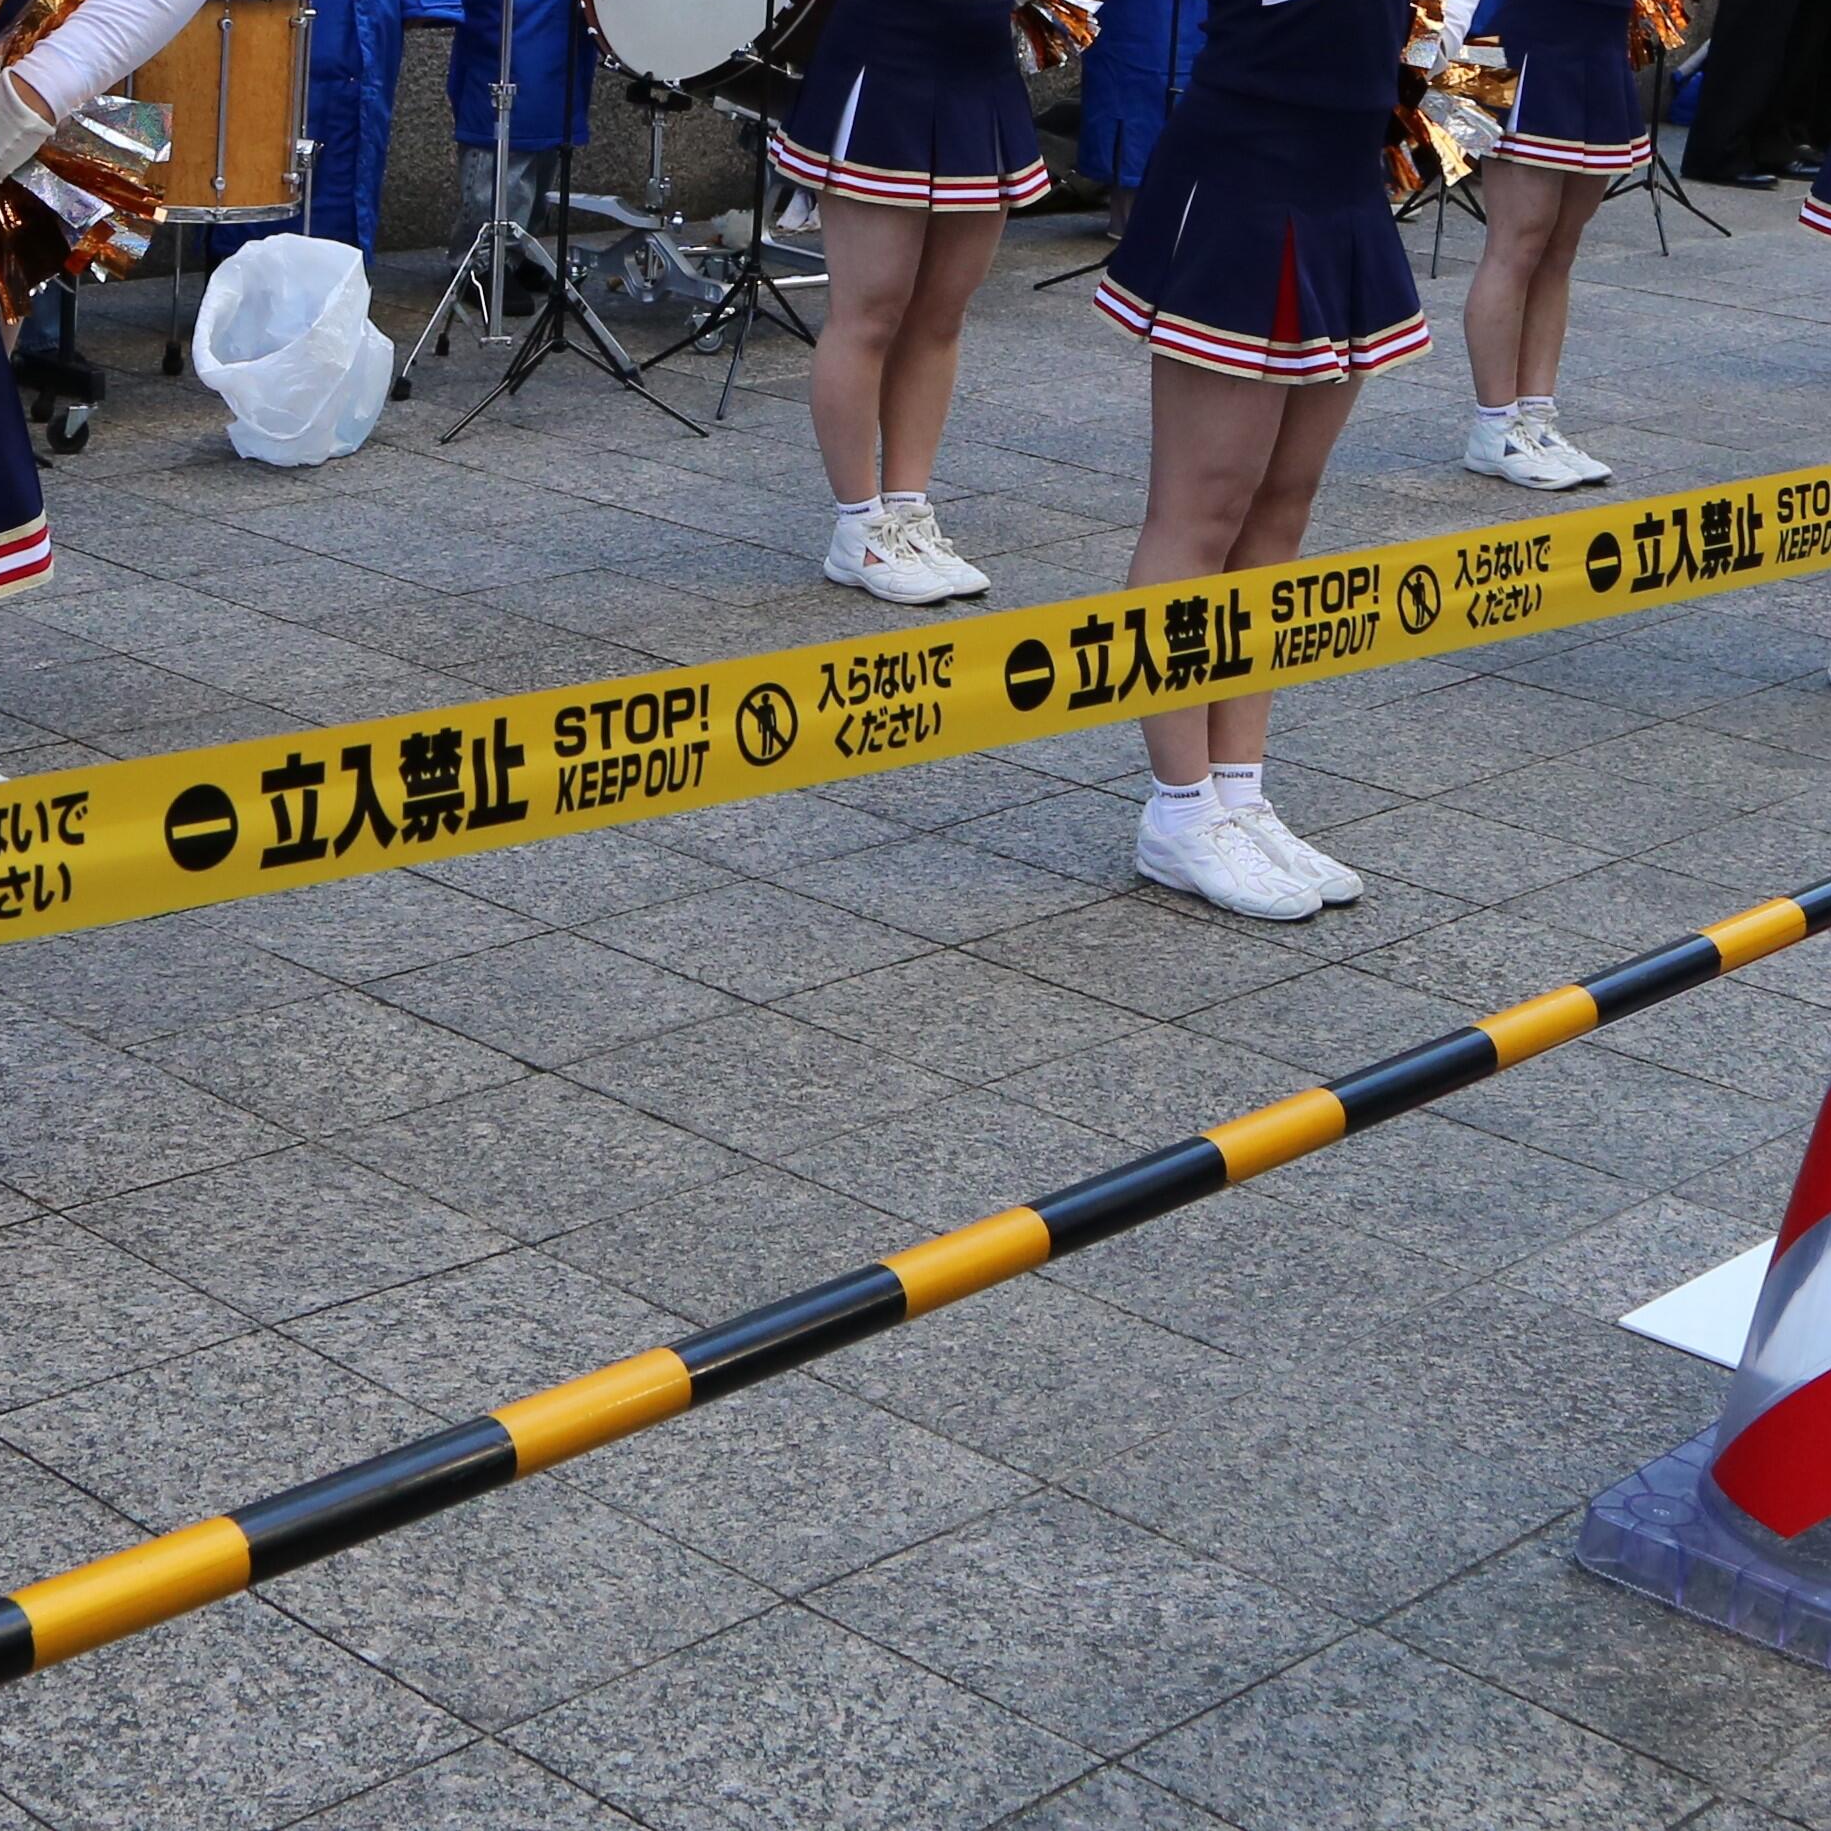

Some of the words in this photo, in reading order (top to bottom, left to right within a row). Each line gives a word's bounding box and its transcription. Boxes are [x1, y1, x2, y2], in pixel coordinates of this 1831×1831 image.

[1455, 535, 1550, 590] 入らないで
[1630, 493, 1764, 593] 立入禁止
[1272, 565, 1379, 623] STOP!
[1466, 584, 1542, 629] ください
[818, 643, 953, 712] 入らないで
[1068, 589, 1253, 710] 立入禁止
[554, 684, 709, 757] STOP!
[835, 702, 941, 758] ください
[260, 717, 528, 870] 立入禁止
